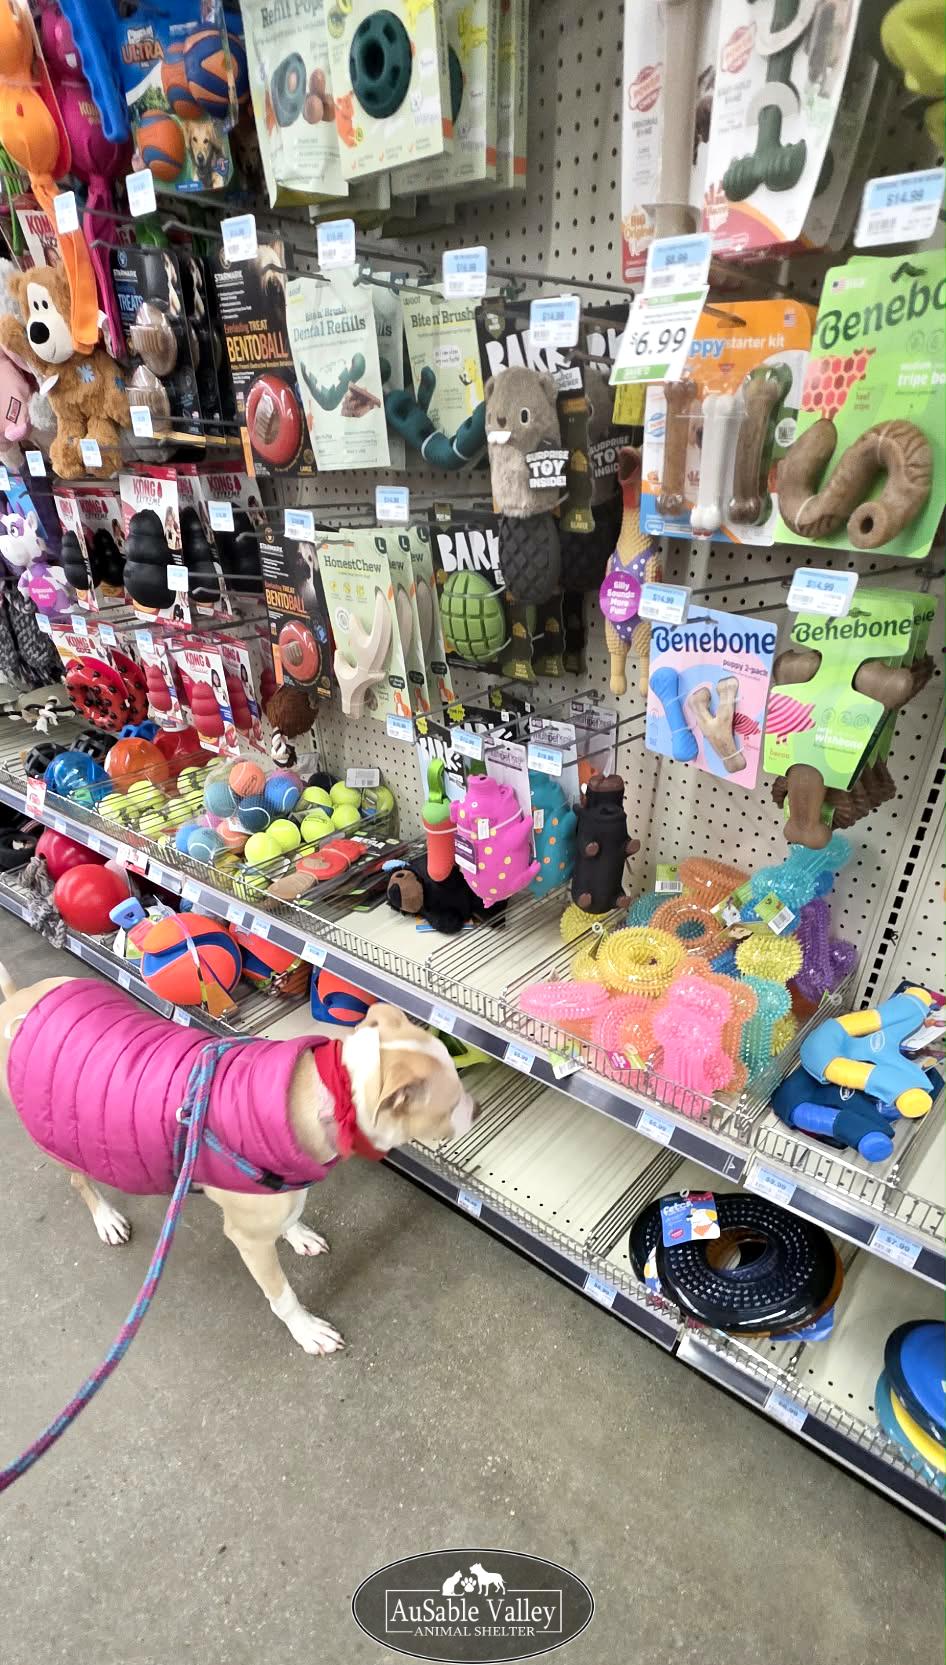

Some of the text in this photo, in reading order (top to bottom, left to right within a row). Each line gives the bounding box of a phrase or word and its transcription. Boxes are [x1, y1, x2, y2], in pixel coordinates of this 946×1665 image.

[122, 39, 164, 64] ULTRA
[411, 313, 433, 328] Bite
[441, 306, 475, 324] Brush
[293, 321, 325, 343] Dental
[327, 314, 367, 336] Refills
[226, 330, 289, 363] BENTOBALL
[629, 326, 688, 356] $6.99
[768, 333, 785, 349] kit
[526, 450, 569, 463] SURPRISE
[529, 459, 566, 477] TOY
[133, 479, 155, 497] KONG
[207, 475, 234, 493] KONG
[324, 555, 381, 573] HonestChew
[792, 616, 912, 643] Benebone
[65, 635, 89, 650] KONG
[651, 625, 776, 655] Benebone
[184, 651, 205, 668] KONG
